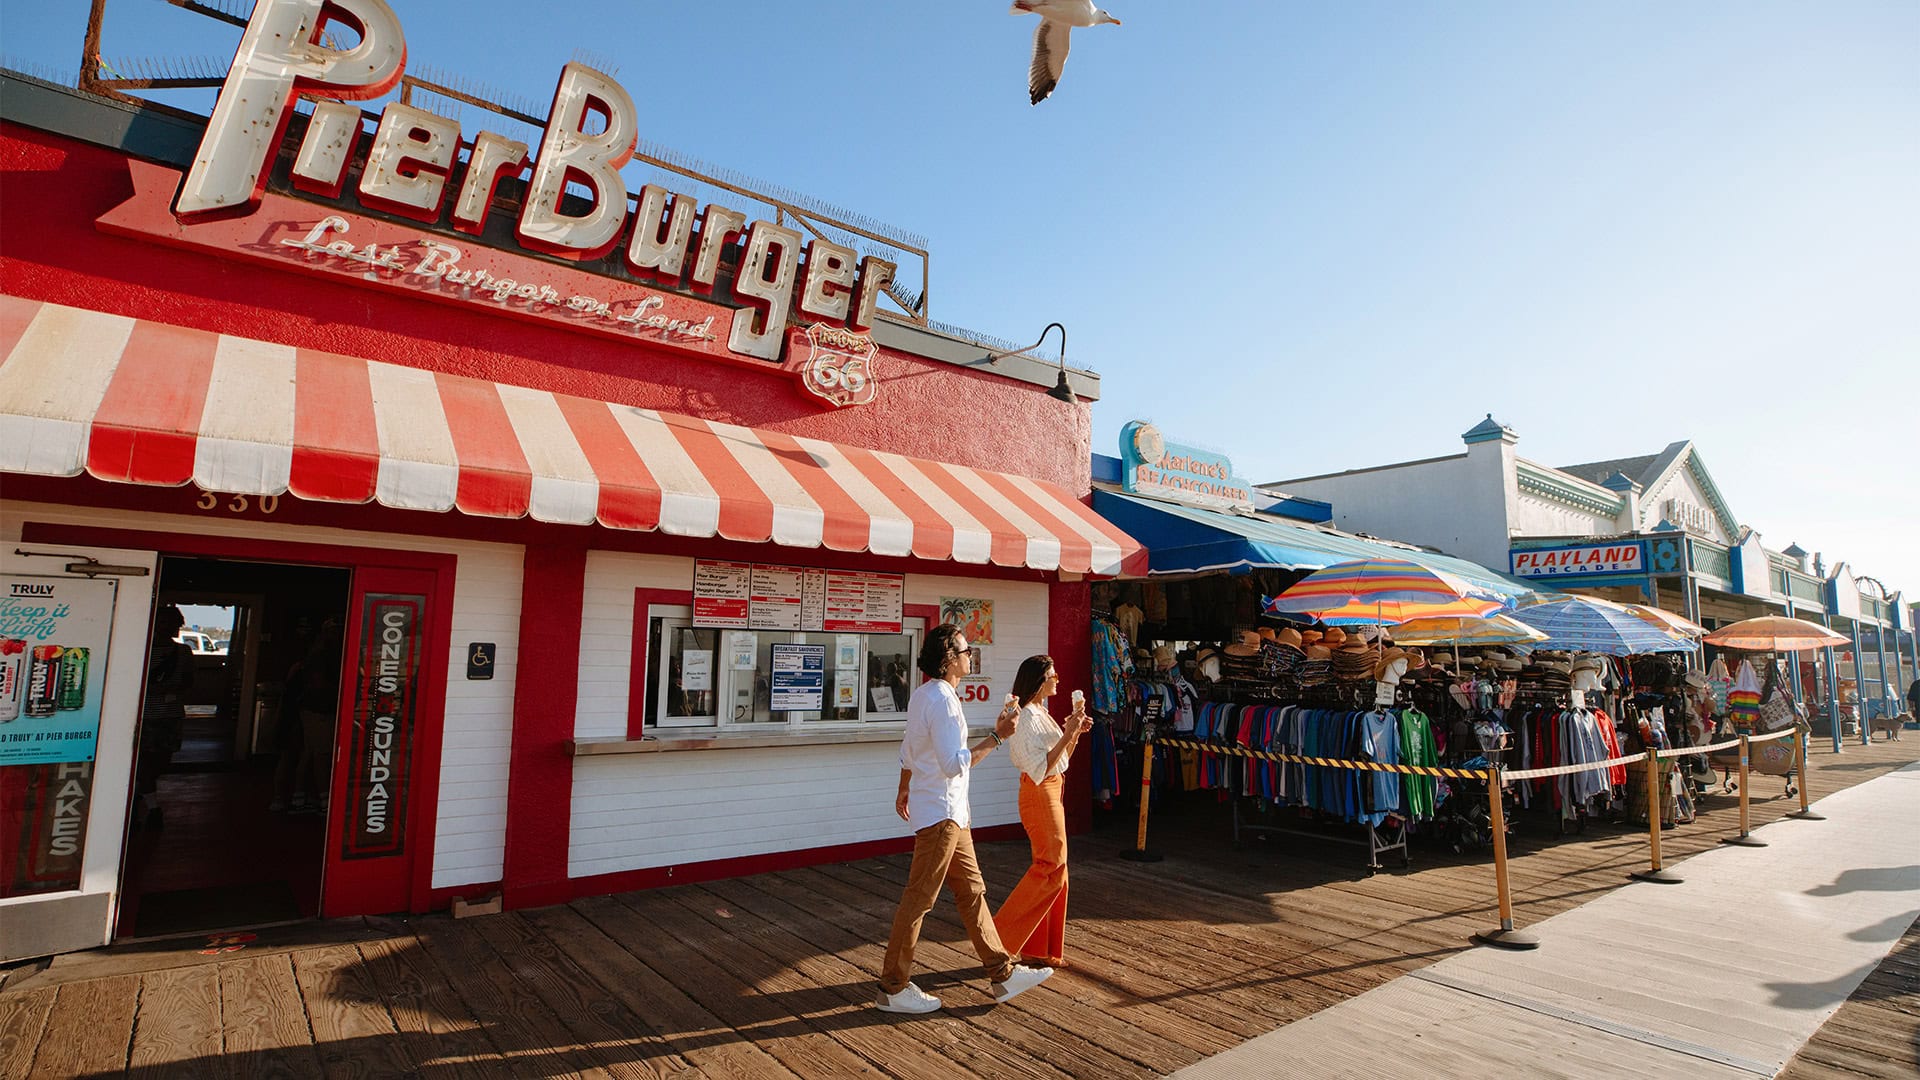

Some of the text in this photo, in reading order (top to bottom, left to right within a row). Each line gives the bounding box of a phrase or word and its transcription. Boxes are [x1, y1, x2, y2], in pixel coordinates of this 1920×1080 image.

[280, 216, 404, 272] Last
[566, 295, 612, 316] on
[617, 295, 717, 342] Land
[813, 354, 866, 393] 66
[1137, 464, 1249, 501] BEACHCOMBER
[1156, 450, 1228, 481] Marlene's
[196, 491, 278, 514] 330
[1516, 546, 1638, 569] PLAYLAND
[1533, 562, 1620, 575] ARCADE
[11, 584, 55, 595] TRULY
[52, 603, 71, 618] it
[377, 611, 405, 693] CONES
[30, 662, 48, 700] TRULY
[35, 733, 44, 741] AT
[46, 732, 62, 740] PIER
[64, 731, 92, 740] BURGER
[366, 717, 395, 834] SUNDAES
[48, 762, 90, 856] HAKES
